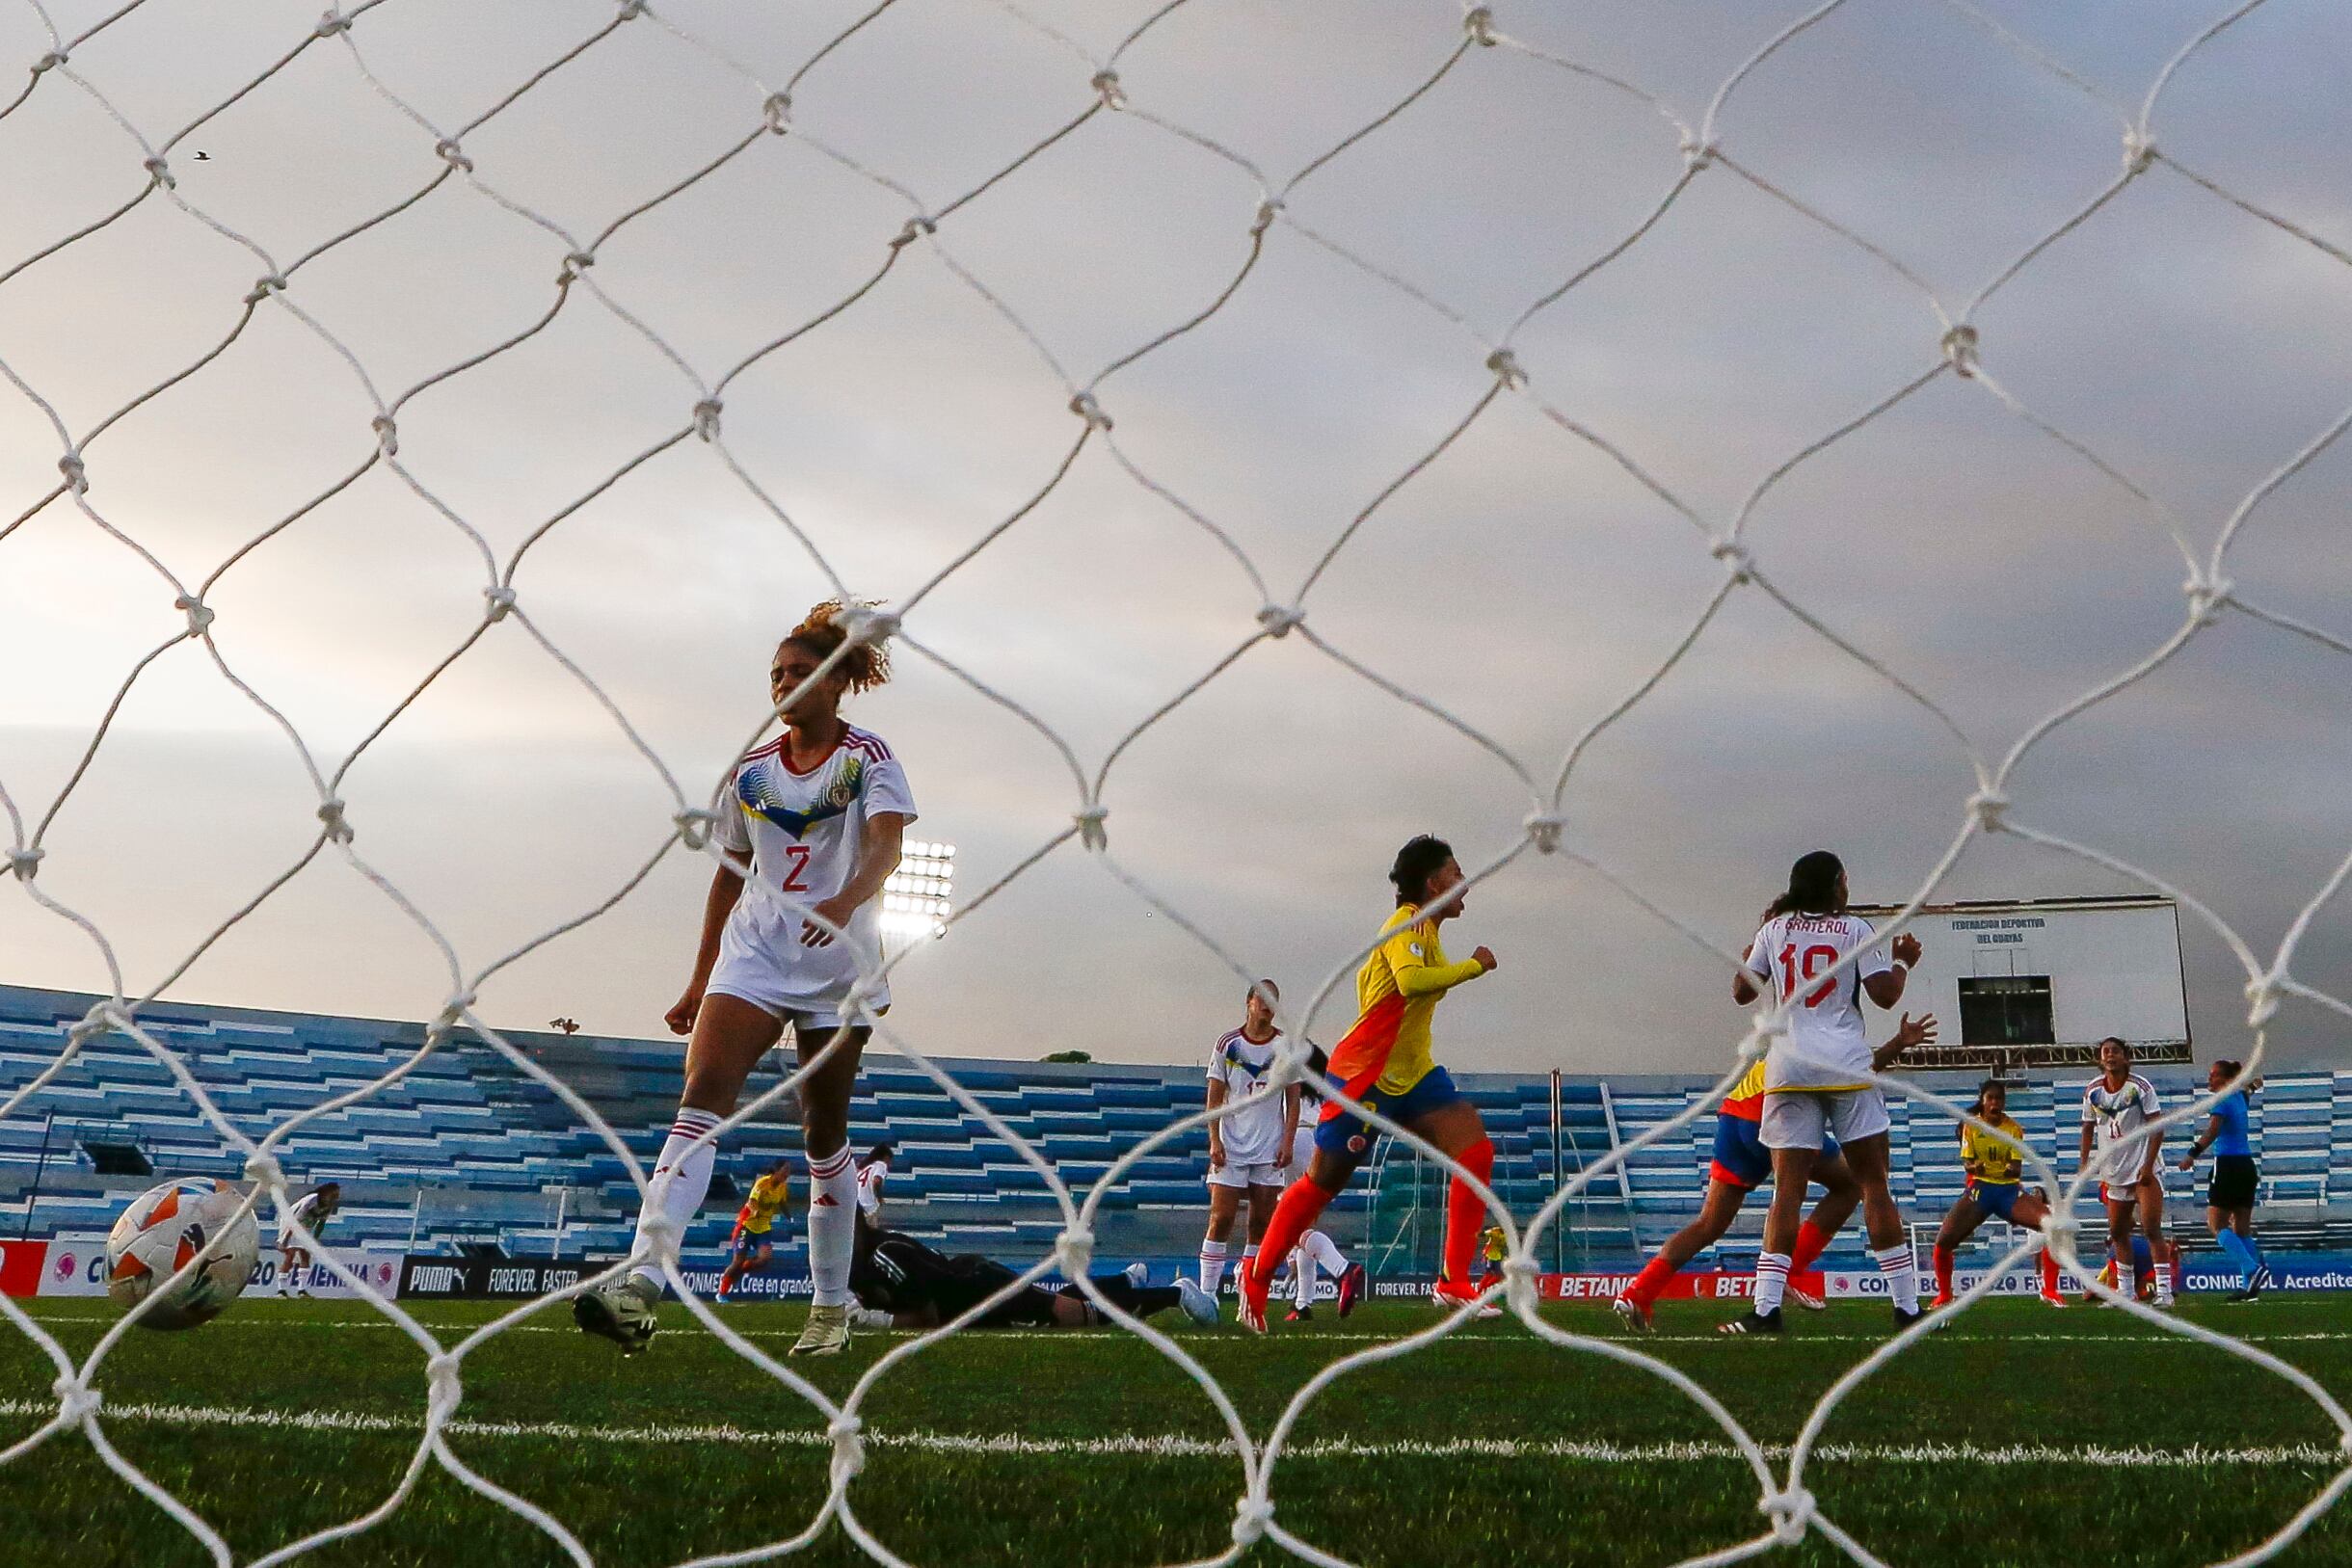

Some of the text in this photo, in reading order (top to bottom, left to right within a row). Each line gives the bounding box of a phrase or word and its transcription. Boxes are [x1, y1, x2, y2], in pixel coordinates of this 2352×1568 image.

[782, 845, 811, 892] 2
[1777, 943, 1839, 1009] 19
[857, 1166, 872, 1187] 4
[409, 1265, 454, 1291] PUMA
[488, 1268, 537, 1292] FOREVER.
[741, 1272, 764, 1292] Cree
[765, 1276, 778, 1292] en
[779, 1274, 814, 1299] grande
[1560, 1277, 1637, 1297] BETAN
